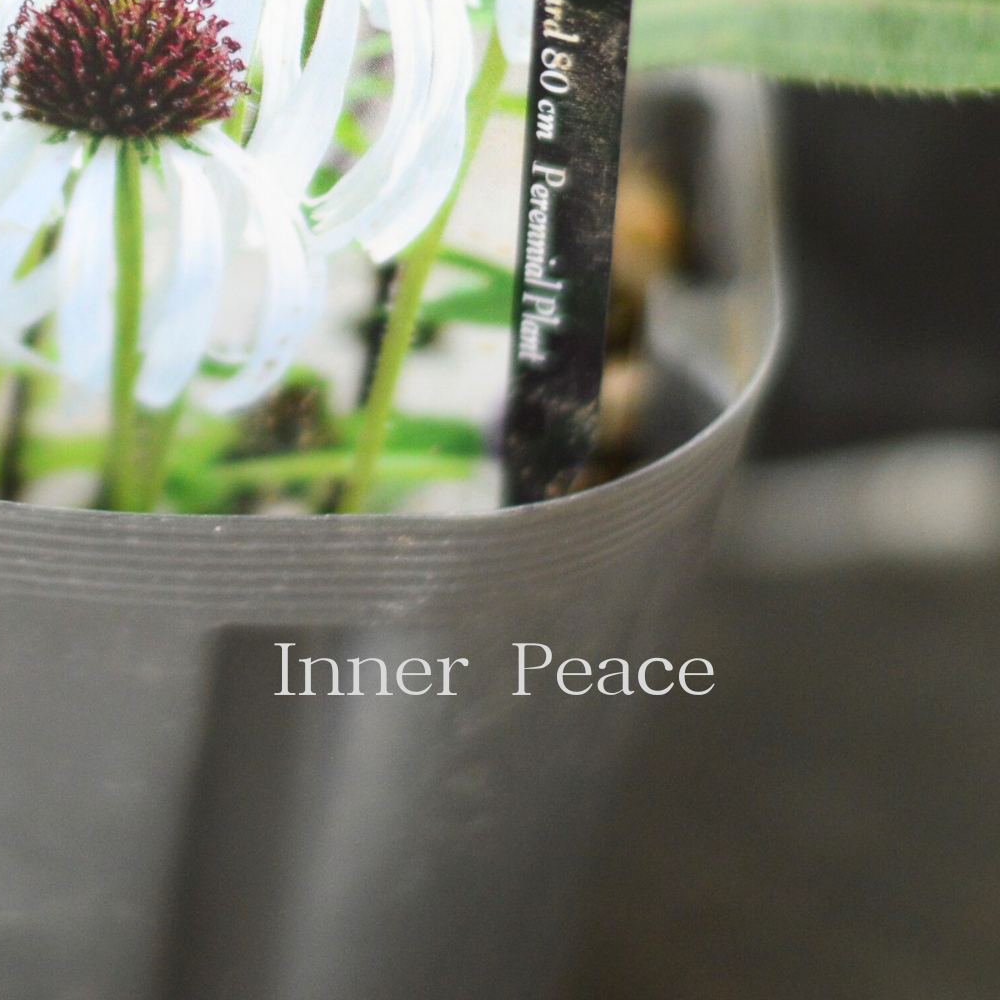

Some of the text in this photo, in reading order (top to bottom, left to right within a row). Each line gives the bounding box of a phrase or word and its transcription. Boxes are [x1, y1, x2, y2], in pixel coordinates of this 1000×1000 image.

[539, 48, 573, 95] 80
[535, 99, 556, 140] cm
[524, 160, 568, 291] Perennial
[518, 291, 562, 363] Plant
